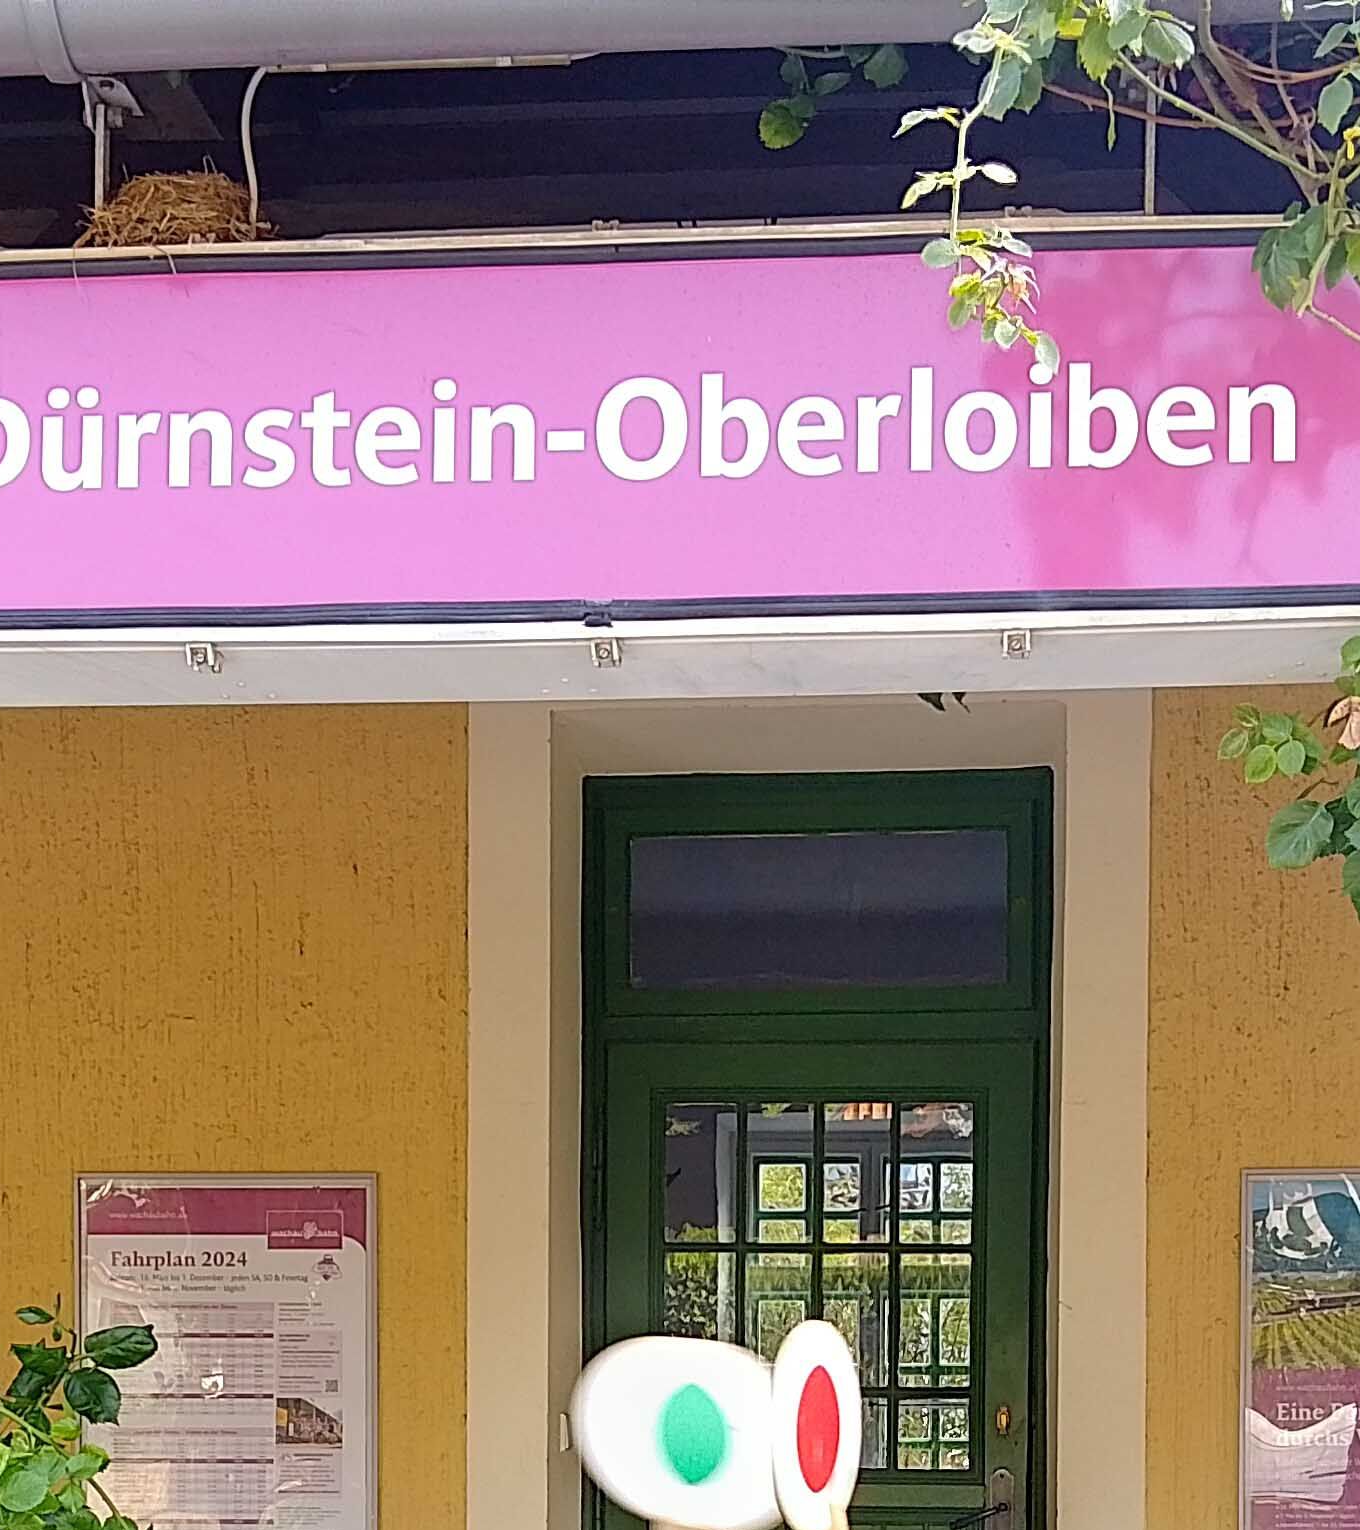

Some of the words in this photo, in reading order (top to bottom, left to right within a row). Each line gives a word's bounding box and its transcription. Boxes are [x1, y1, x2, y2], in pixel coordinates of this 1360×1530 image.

[111, 1250, 196, 1271] Fahrplan
[201, 1251, 248, 1267] 2024
[1277, 1402, 1325, 1421] Eine
